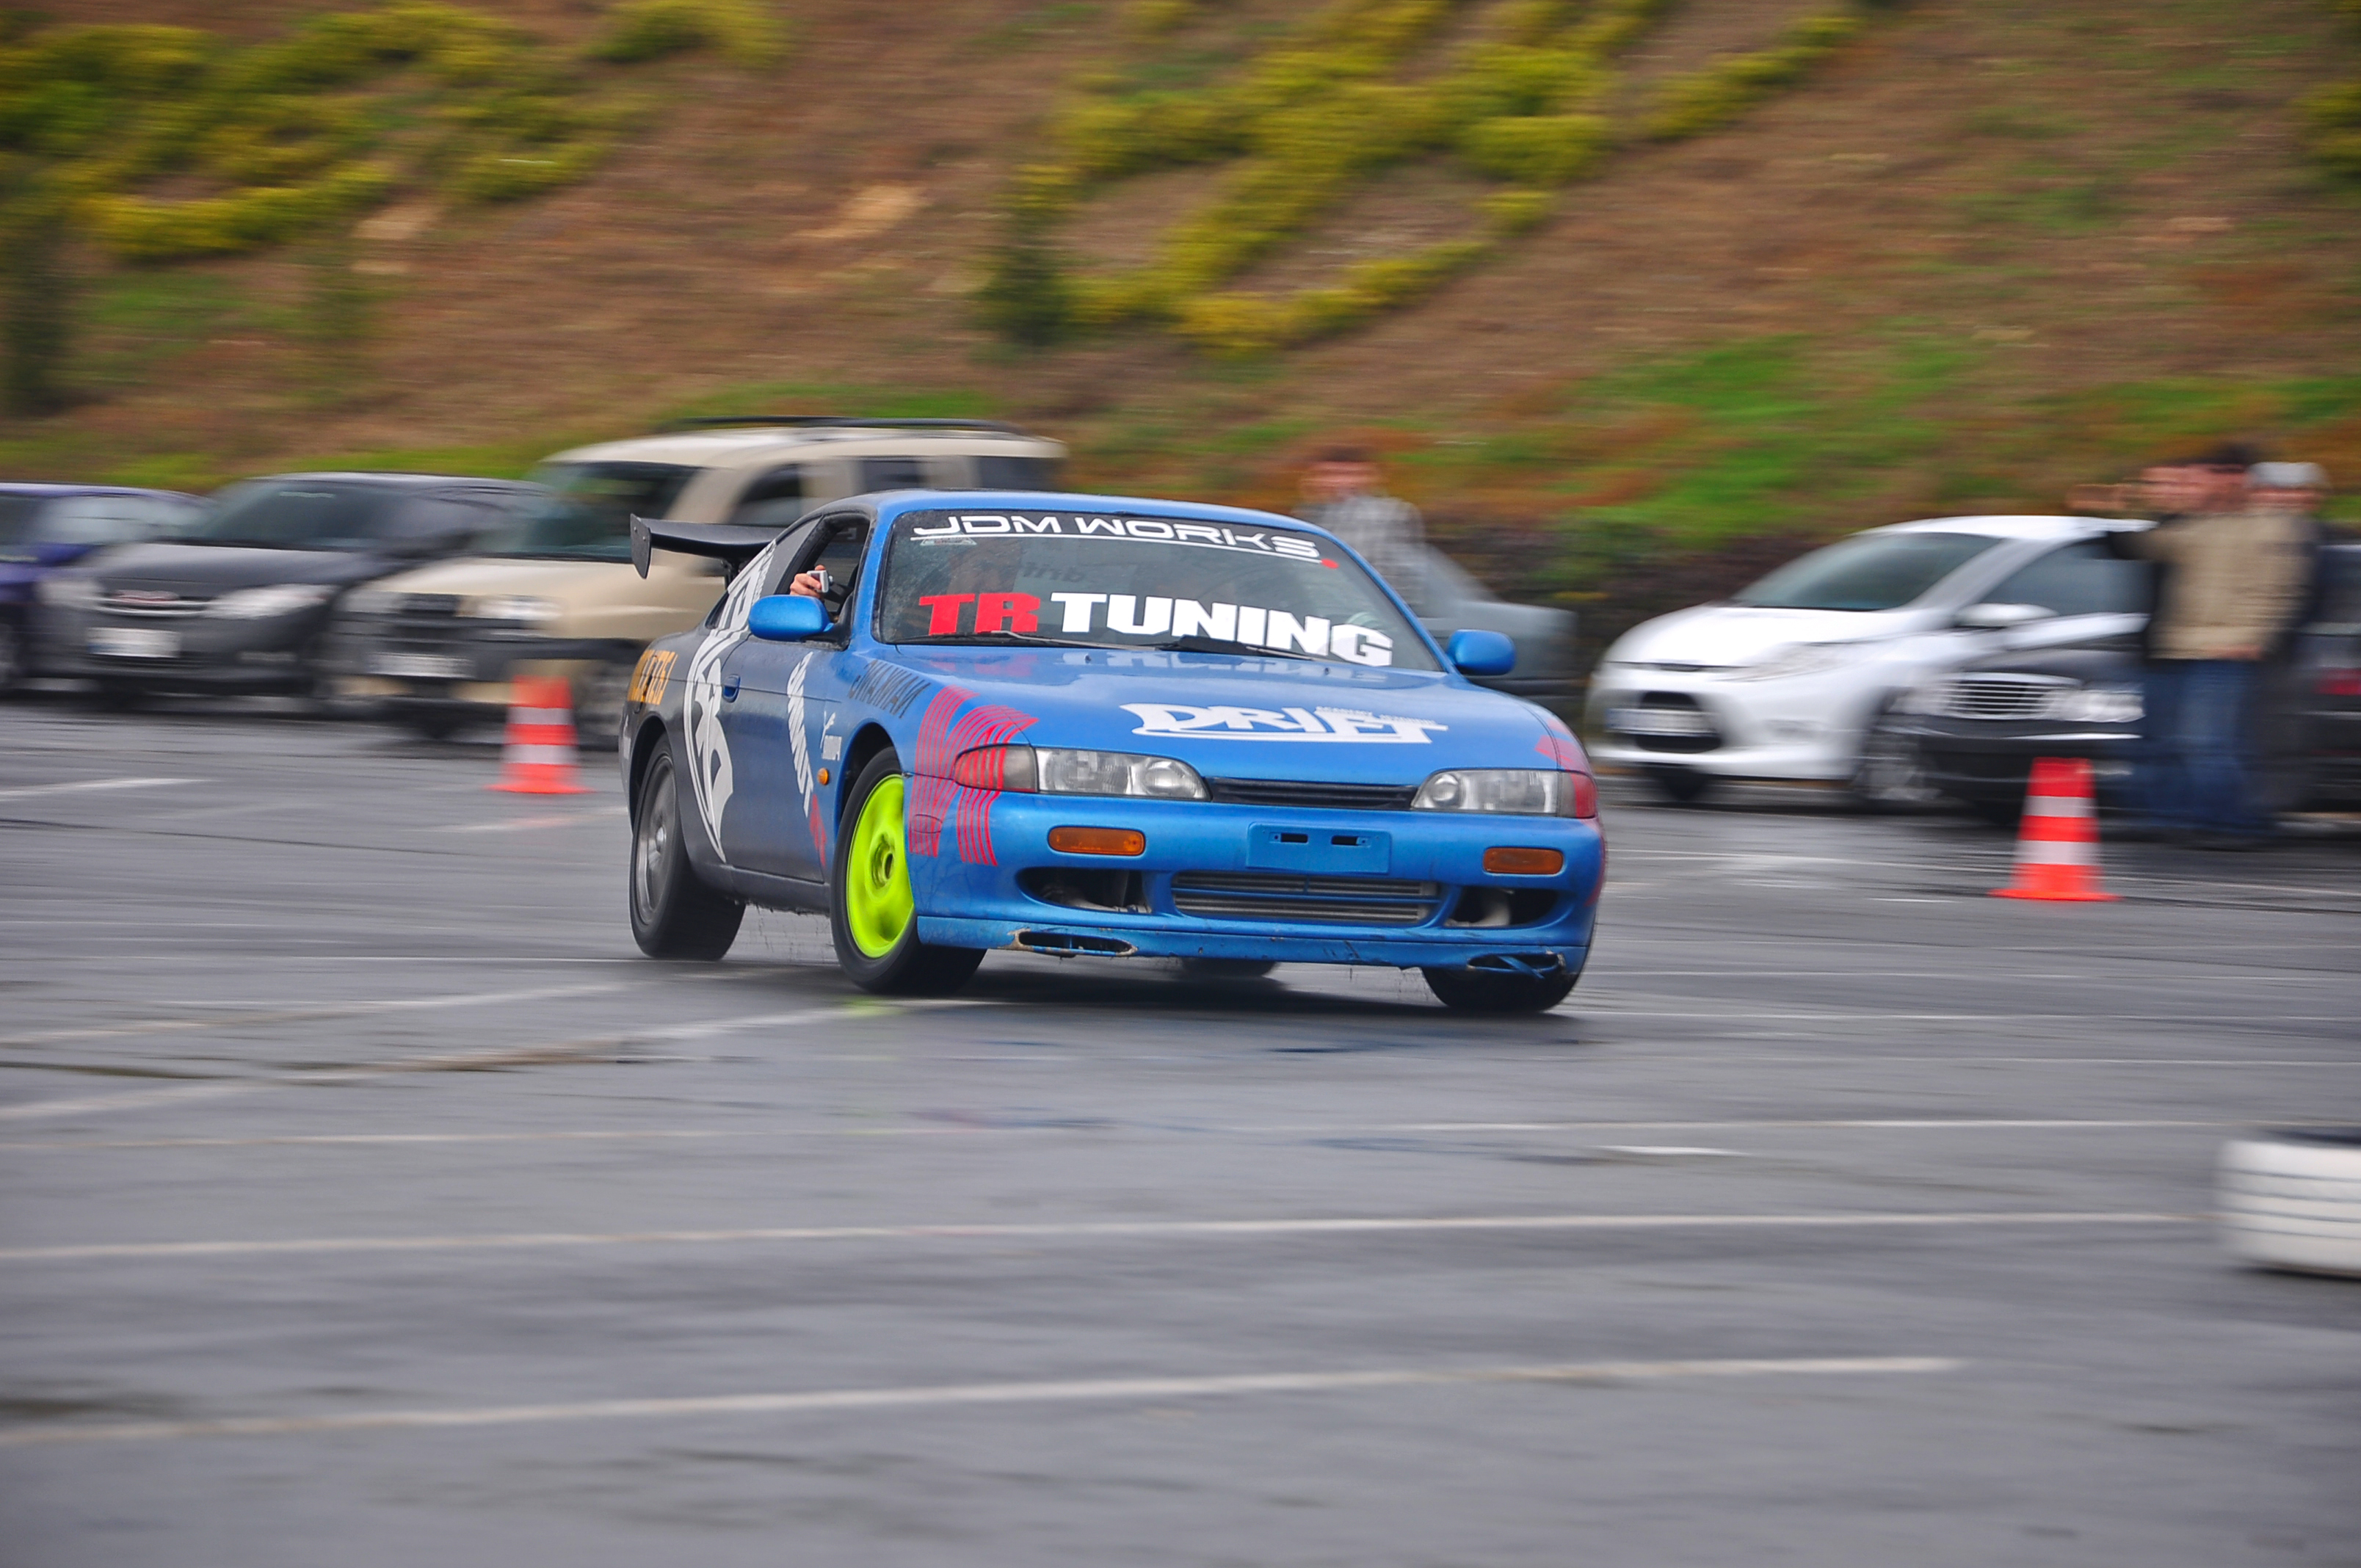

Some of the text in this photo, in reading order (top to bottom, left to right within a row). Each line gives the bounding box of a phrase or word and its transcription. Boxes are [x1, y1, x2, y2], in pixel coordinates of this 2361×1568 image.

[913, 516, 1320, 558] JDM WORKS
[918, 592, 1393, 667] TR TUNING
[1120, 703, 1448, 744] DRIFT
